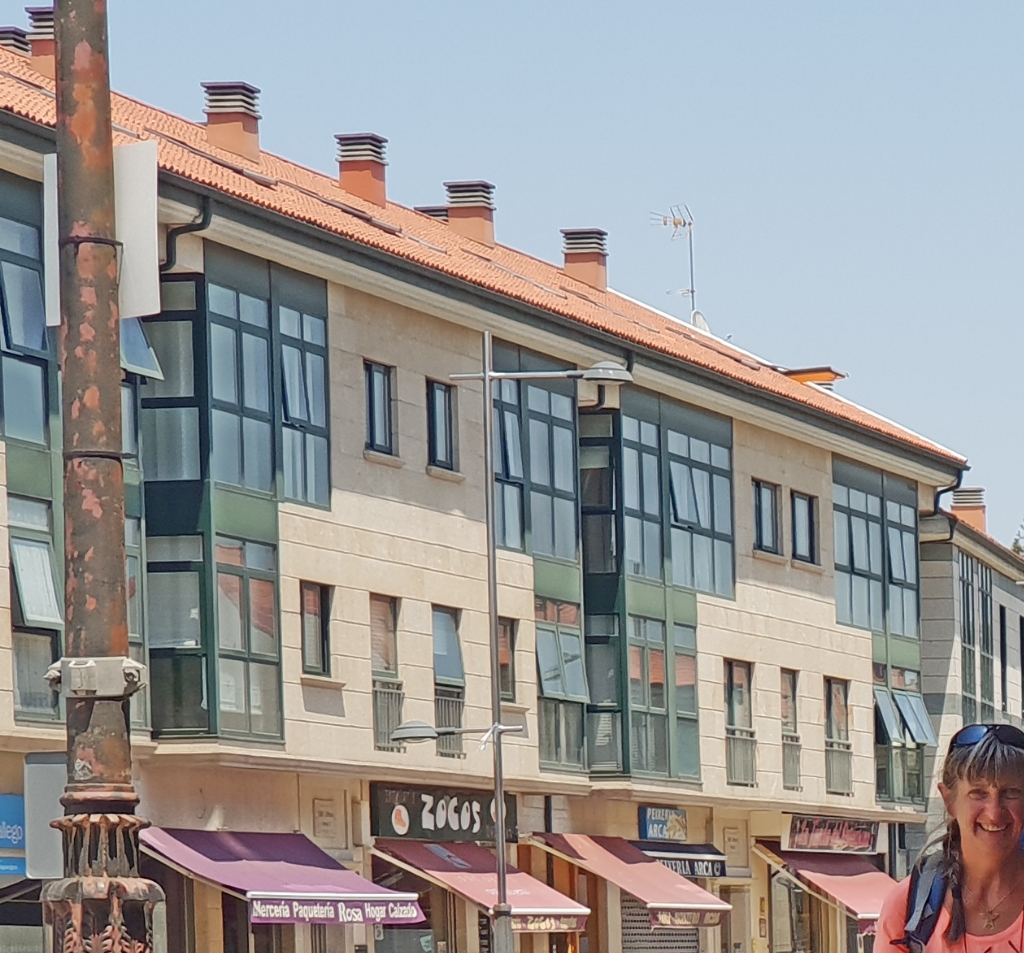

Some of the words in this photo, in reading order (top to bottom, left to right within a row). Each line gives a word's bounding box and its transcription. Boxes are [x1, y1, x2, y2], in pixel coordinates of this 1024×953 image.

[421, 793, 481, 834] ZOCOS
[648, 823, 667, 838] ARCA
[656, 859, 692, 876] XERIA
[694, 861, 713, 876] ARCA
[337, 902, 364, 922] Rosa
[365, 902, 387, 922] Hogar
[388, 902, 418, 918] Calzado
